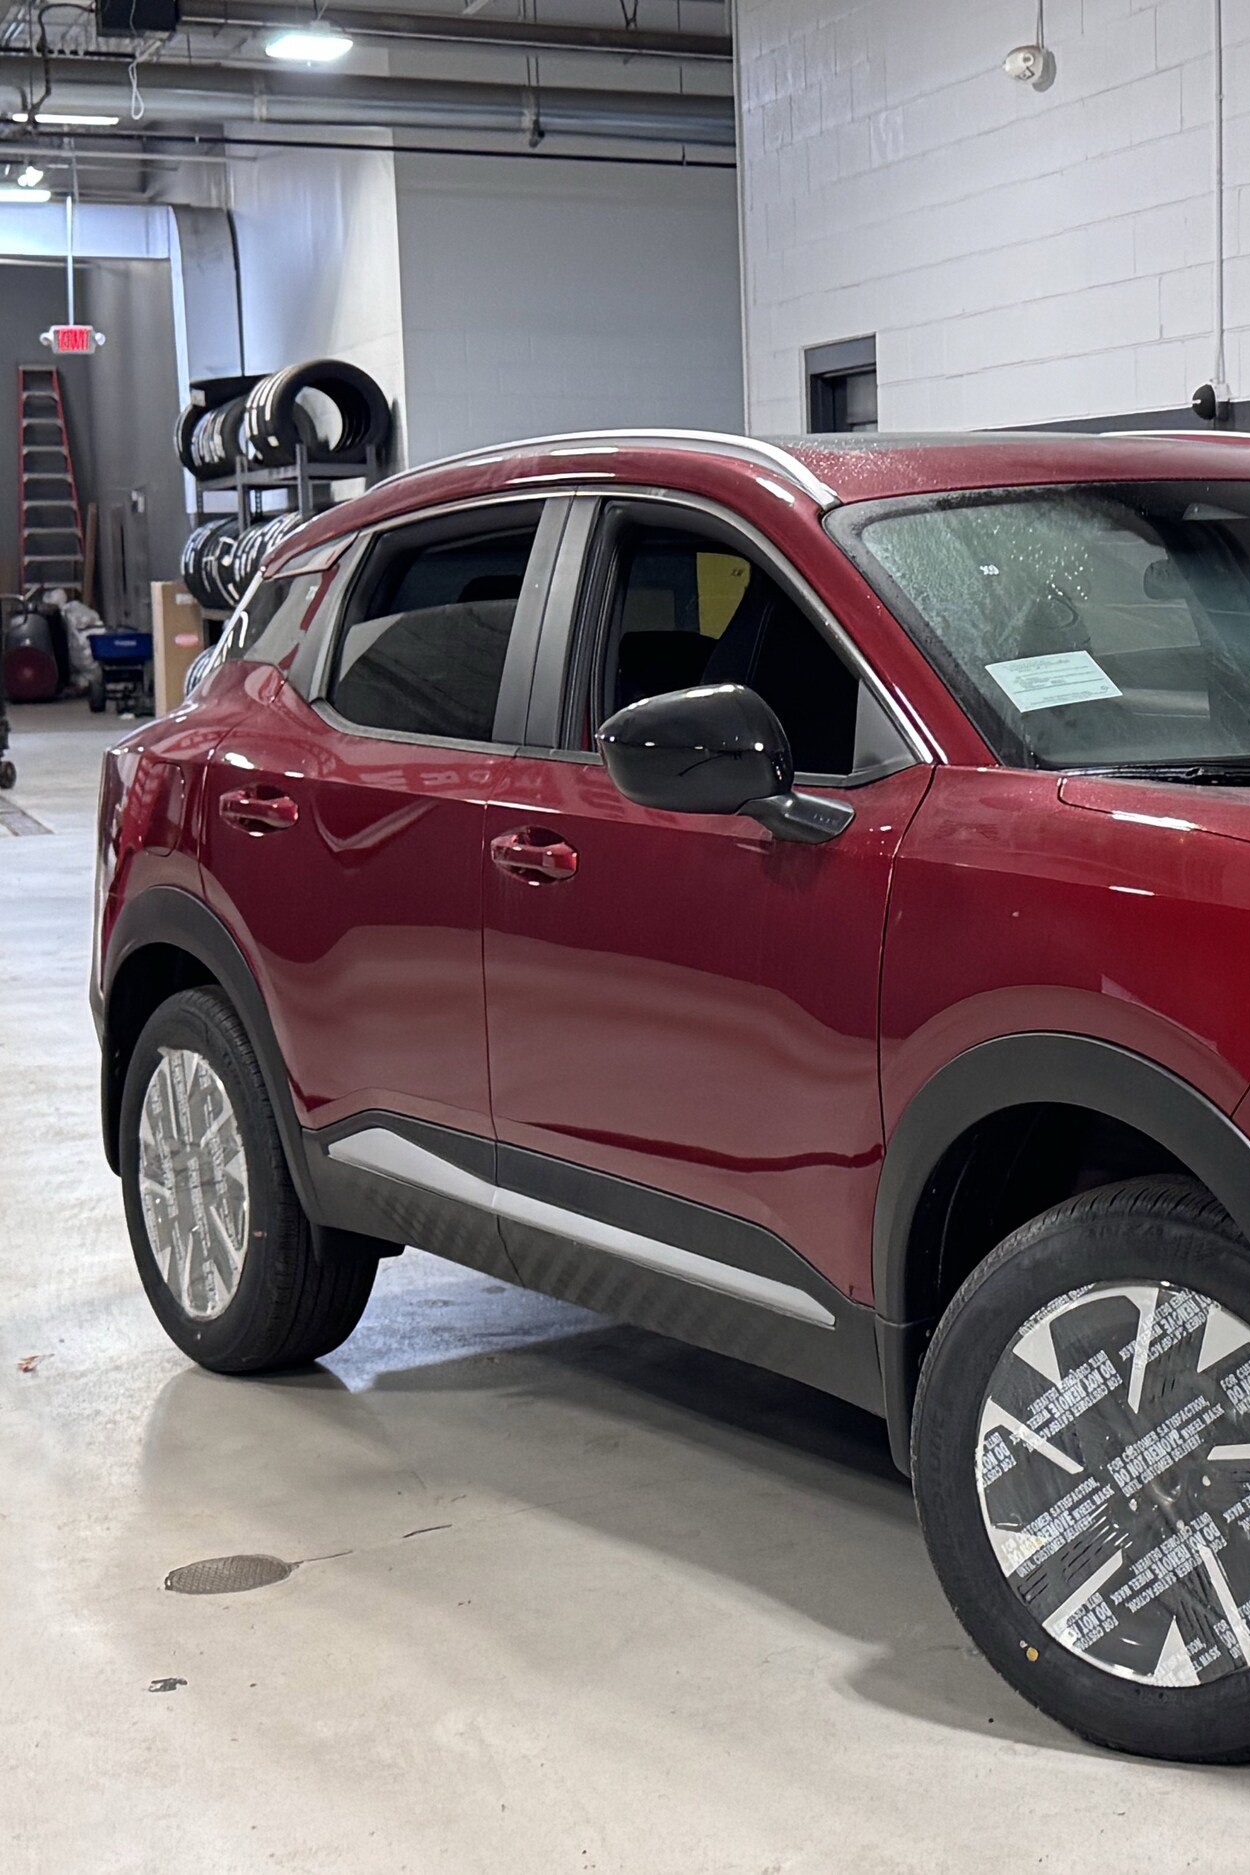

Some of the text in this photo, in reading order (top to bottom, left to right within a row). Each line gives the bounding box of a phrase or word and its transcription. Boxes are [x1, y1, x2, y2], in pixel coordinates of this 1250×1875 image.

[1088, 1350, 1109, 1369] UNTIL
[1100, 1360, 1117, 1380] DO
[1083, 1370, 1104, 1392] NOT
[1107, 1373, 1123, 1391] FOR
[1220, 1374, 1238, 1391] FOR
[1048, 1382, 1087, 1418] REMOVE
[1073, 1385, 1108, 1417] CUSTOMER
[1226, 1385, 1246, 1404] DO
[1026, 1410, 1052, 1431] WHEEL
[1107, 1395, 1210, 1475] FOR CUSTOMER SATISFACTION,
[1113, 1403, 1225, 1488] DO NOT REMOVE WHEEL MASK
[994, 1441, 1011, 1460] DO
[1001, 1454, 1017, 1472] FOR
[1121, 1434, 1205, 1498] UNTIL CUSTOMER DELIVERY.
[1049, 1476, 1100, 1517] SATISFACTION,
[1036, 1510, 1076, 1542] REMOVE
[1072, 1500, 1096, 1520] WHEEL
[1092, 1483, 1115, 1505] MASK
[1223, 1502, 1245, 1523] MASK
[1203, 1521, 1221, 1541] DO
[1129, 1512, 1213, 1576] UNTIL CUSTOMER DELIVERY.
[1209, 1535, 1228, 1553] FOR
[1015, 1561, 1037, 1578] UNTIL
[1032, 1535, 1067, 1564] CUSTOMER
[1151, 1543, 1191, 1579] REMOVE
[1128, 1568, 1155, 1591] WHEEL
[1110, 1584, 1132, 1606] MASK
[1125, 1571, 1177, 1614] SATISFACTION,
[1079, 1601, 1112, 1632] DO NOT
[1102, 1614, 1119, 1633] FOR
[1199, 1644, 1223, 1667] MASK
